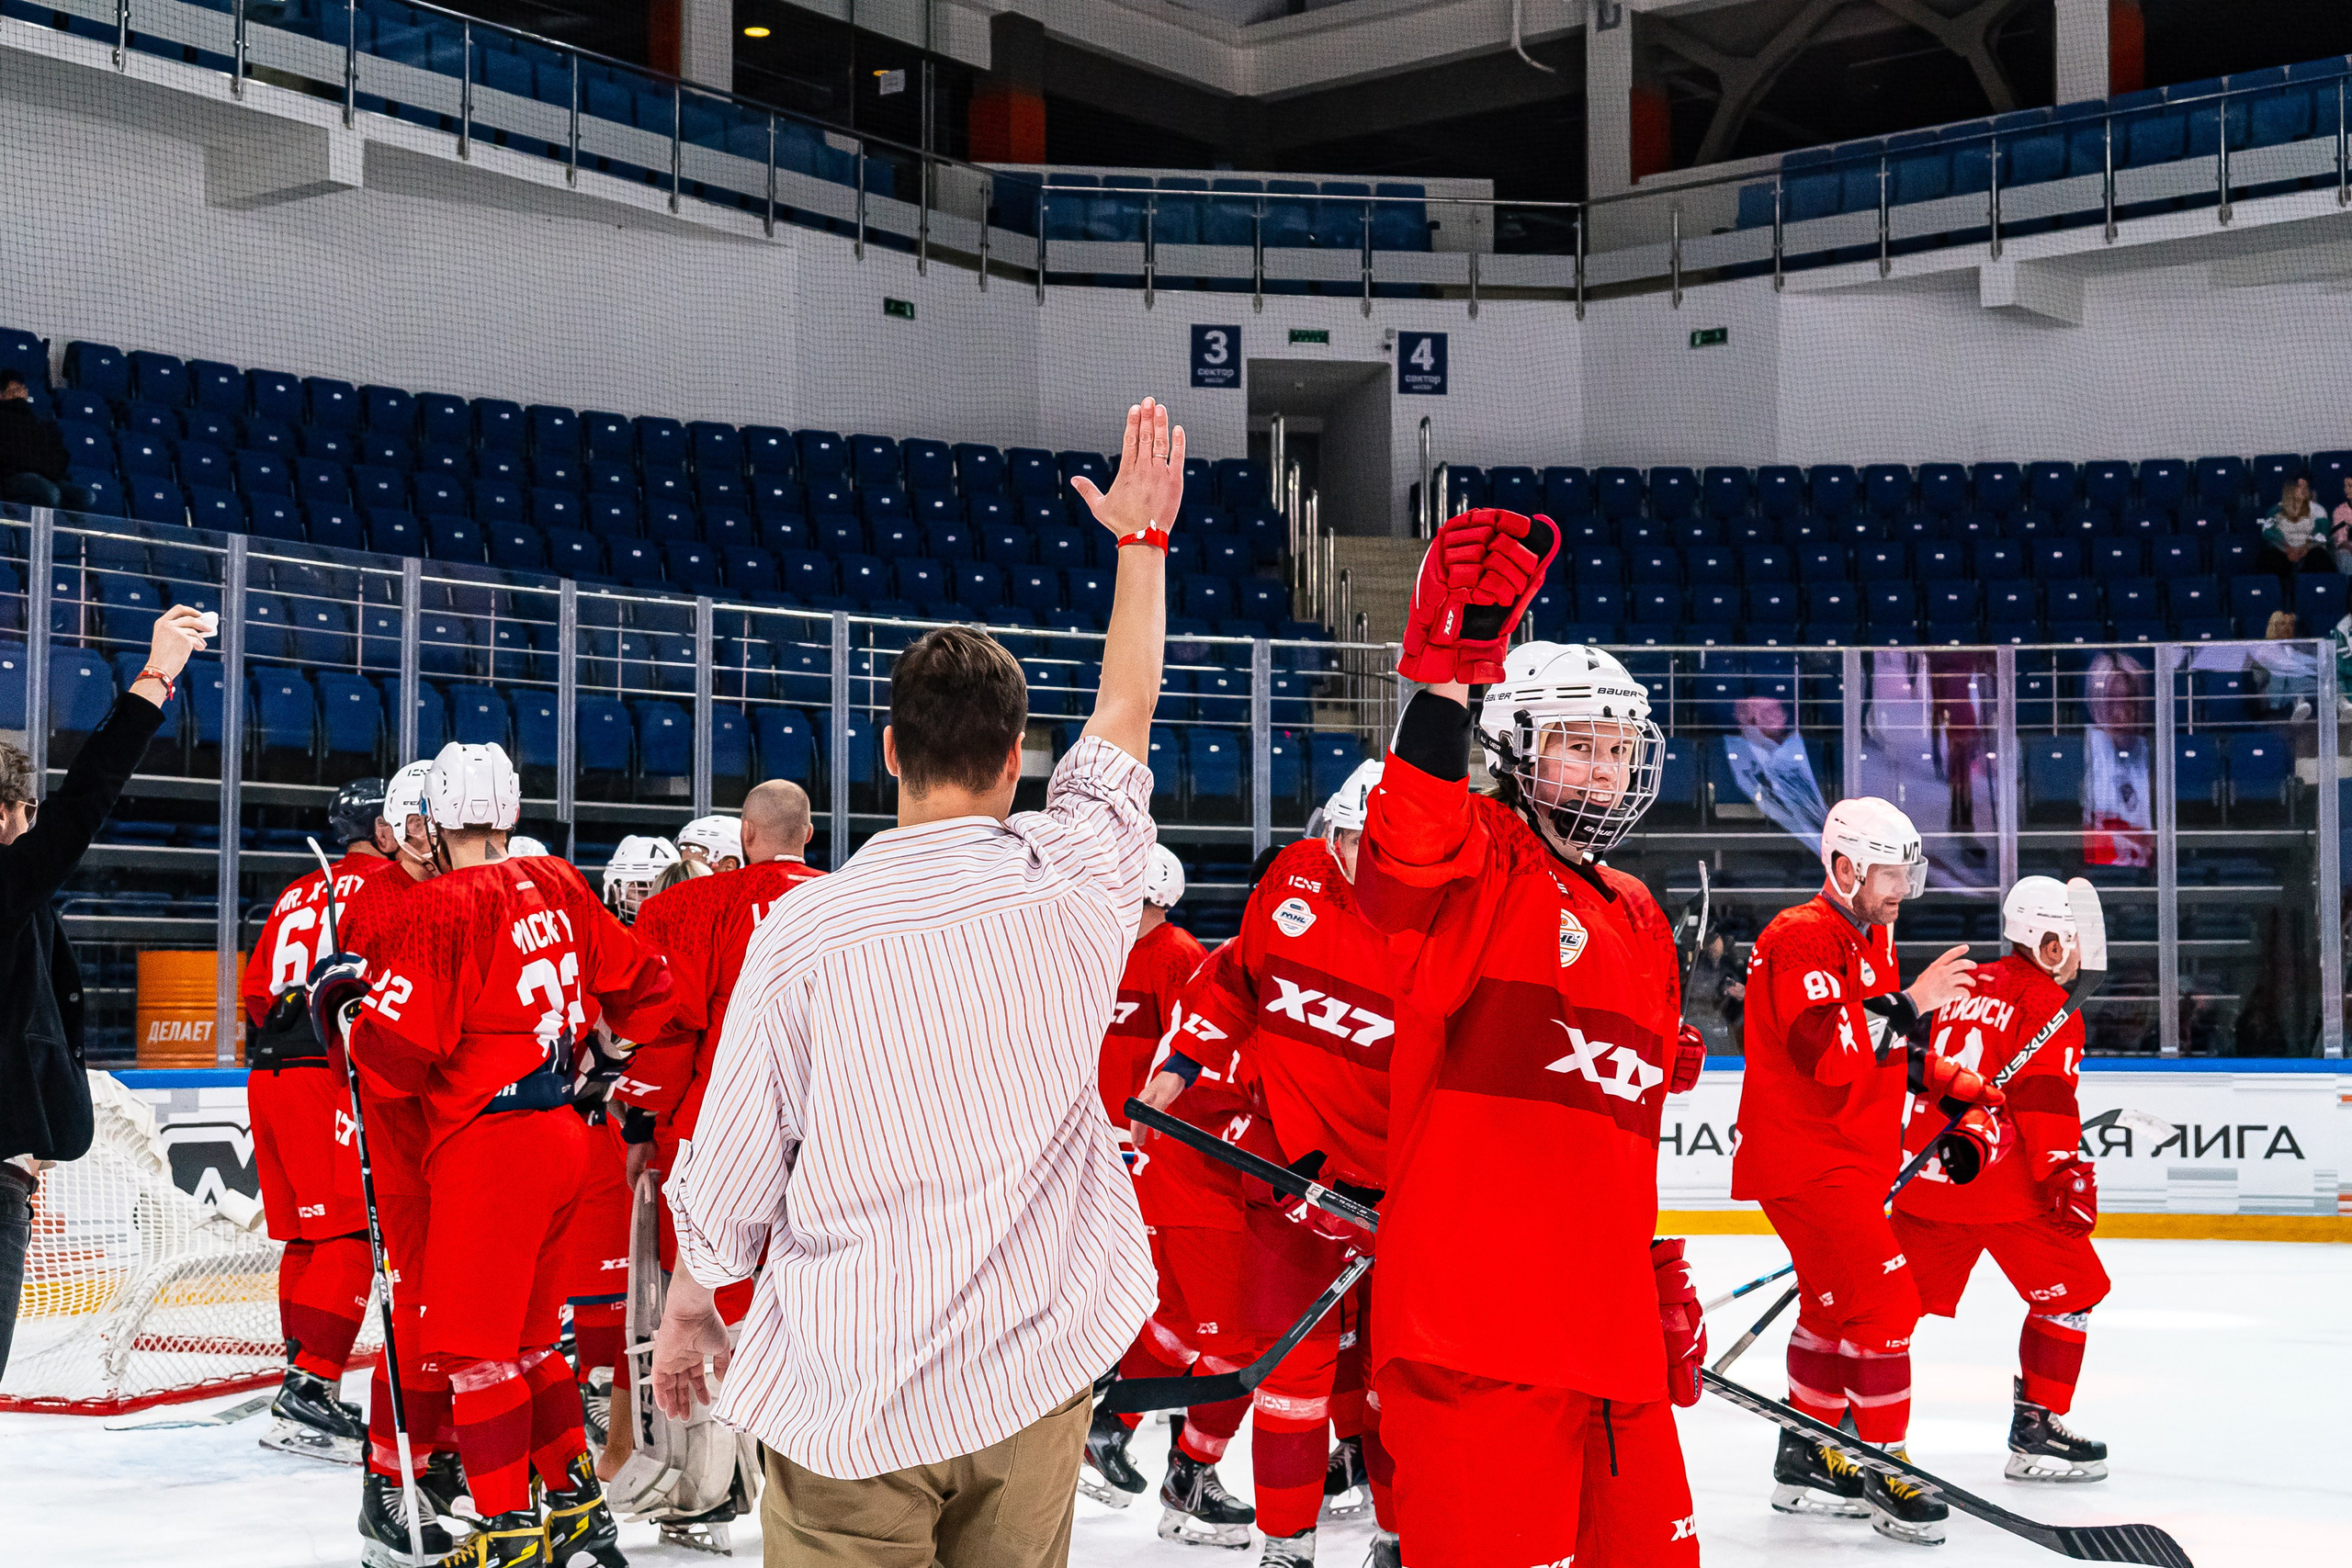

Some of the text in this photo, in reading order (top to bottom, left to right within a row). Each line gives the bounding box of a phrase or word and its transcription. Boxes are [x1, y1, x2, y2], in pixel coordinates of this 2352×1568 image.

[1204, 330, 1228, 364] 3
[1410, 337, 1434, 370] 4
[1597, 686, 1639, 698] BAUER
[275, 886, 303, 917] MR.
[1804, 970, 1841, 1000] 81
[1264, 975, 1396, 1047] X17
[148, 1020, 214, 1043] ДЕЛАЕТ
[1991, 1008, 2069, 1090] NEXUS
[1670, 1514, 1697, 1542] X1
